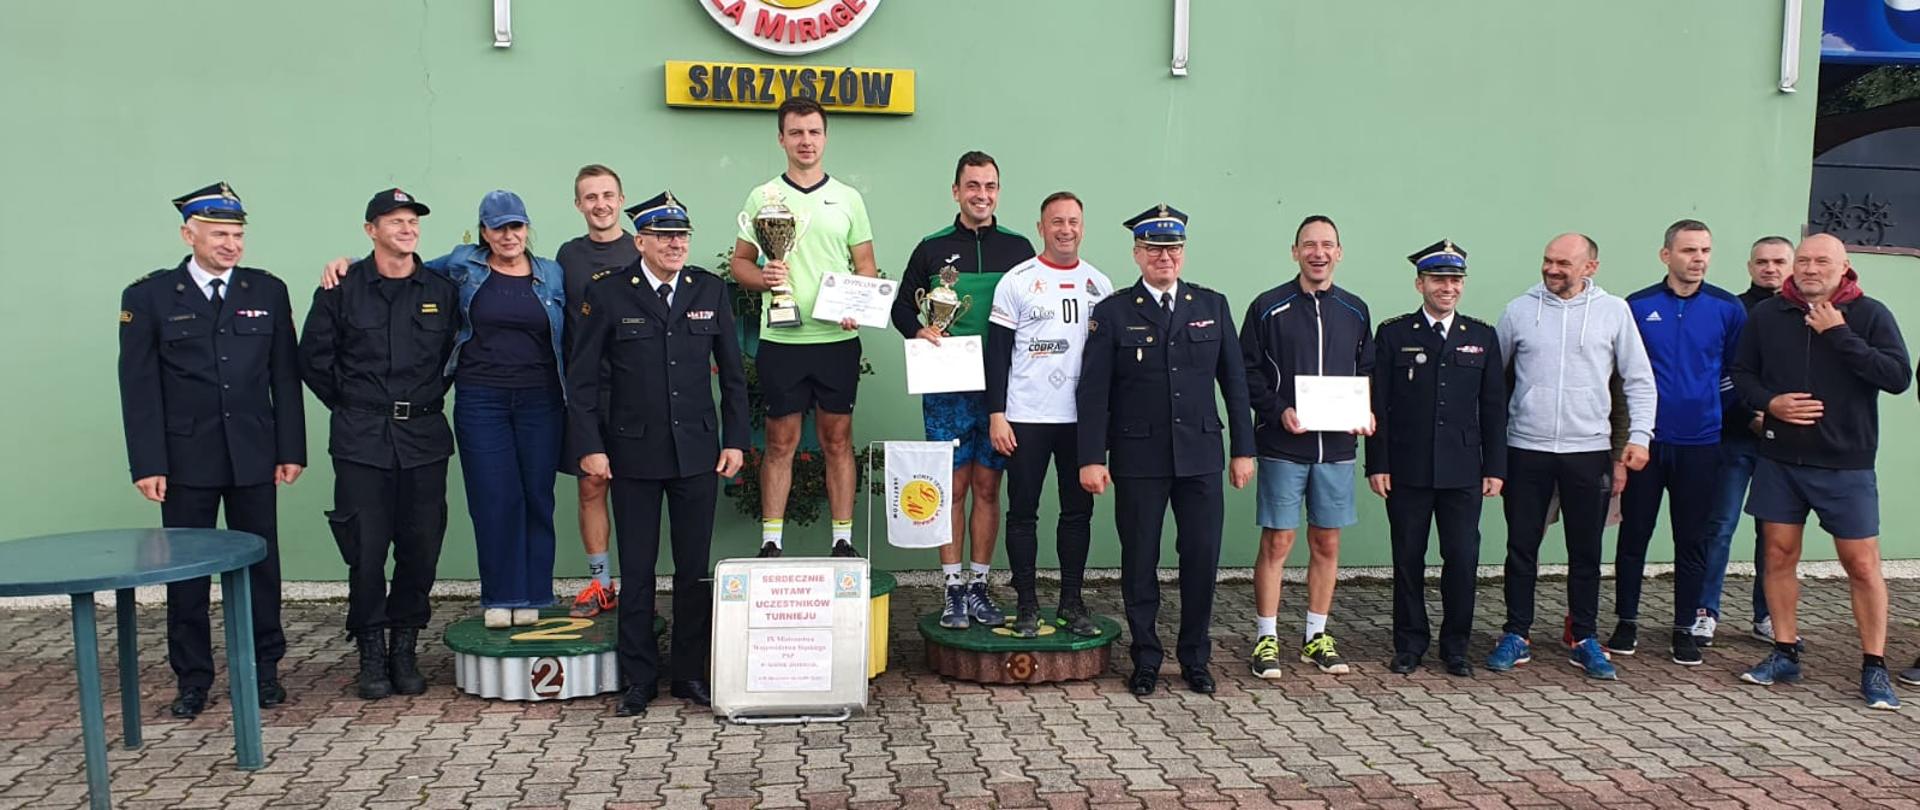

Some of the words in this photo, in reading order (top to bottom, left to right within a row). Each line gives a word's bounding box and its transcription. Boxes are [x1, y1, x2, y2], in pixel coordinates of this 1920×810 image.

[754, 0, 867, 44] MIRAGE
[688, 64, 894, 107] SKRZYSZÓW
[1062, 298, 1078, 324] 01
[1029, 343, 1061, 352] COBRA
[762, 574, 825, 583] SERDECZNIE
[756, 598, 830, 609] UCZESTNIKÓW
[771, 587, 812, 596] WITAMY
[766, 612, 817, 621] TURNIEJU
[509, 617, 595, 641] 2
[533, 657, 561, 694] 2
[1012, 653, 1032, 679] 3
